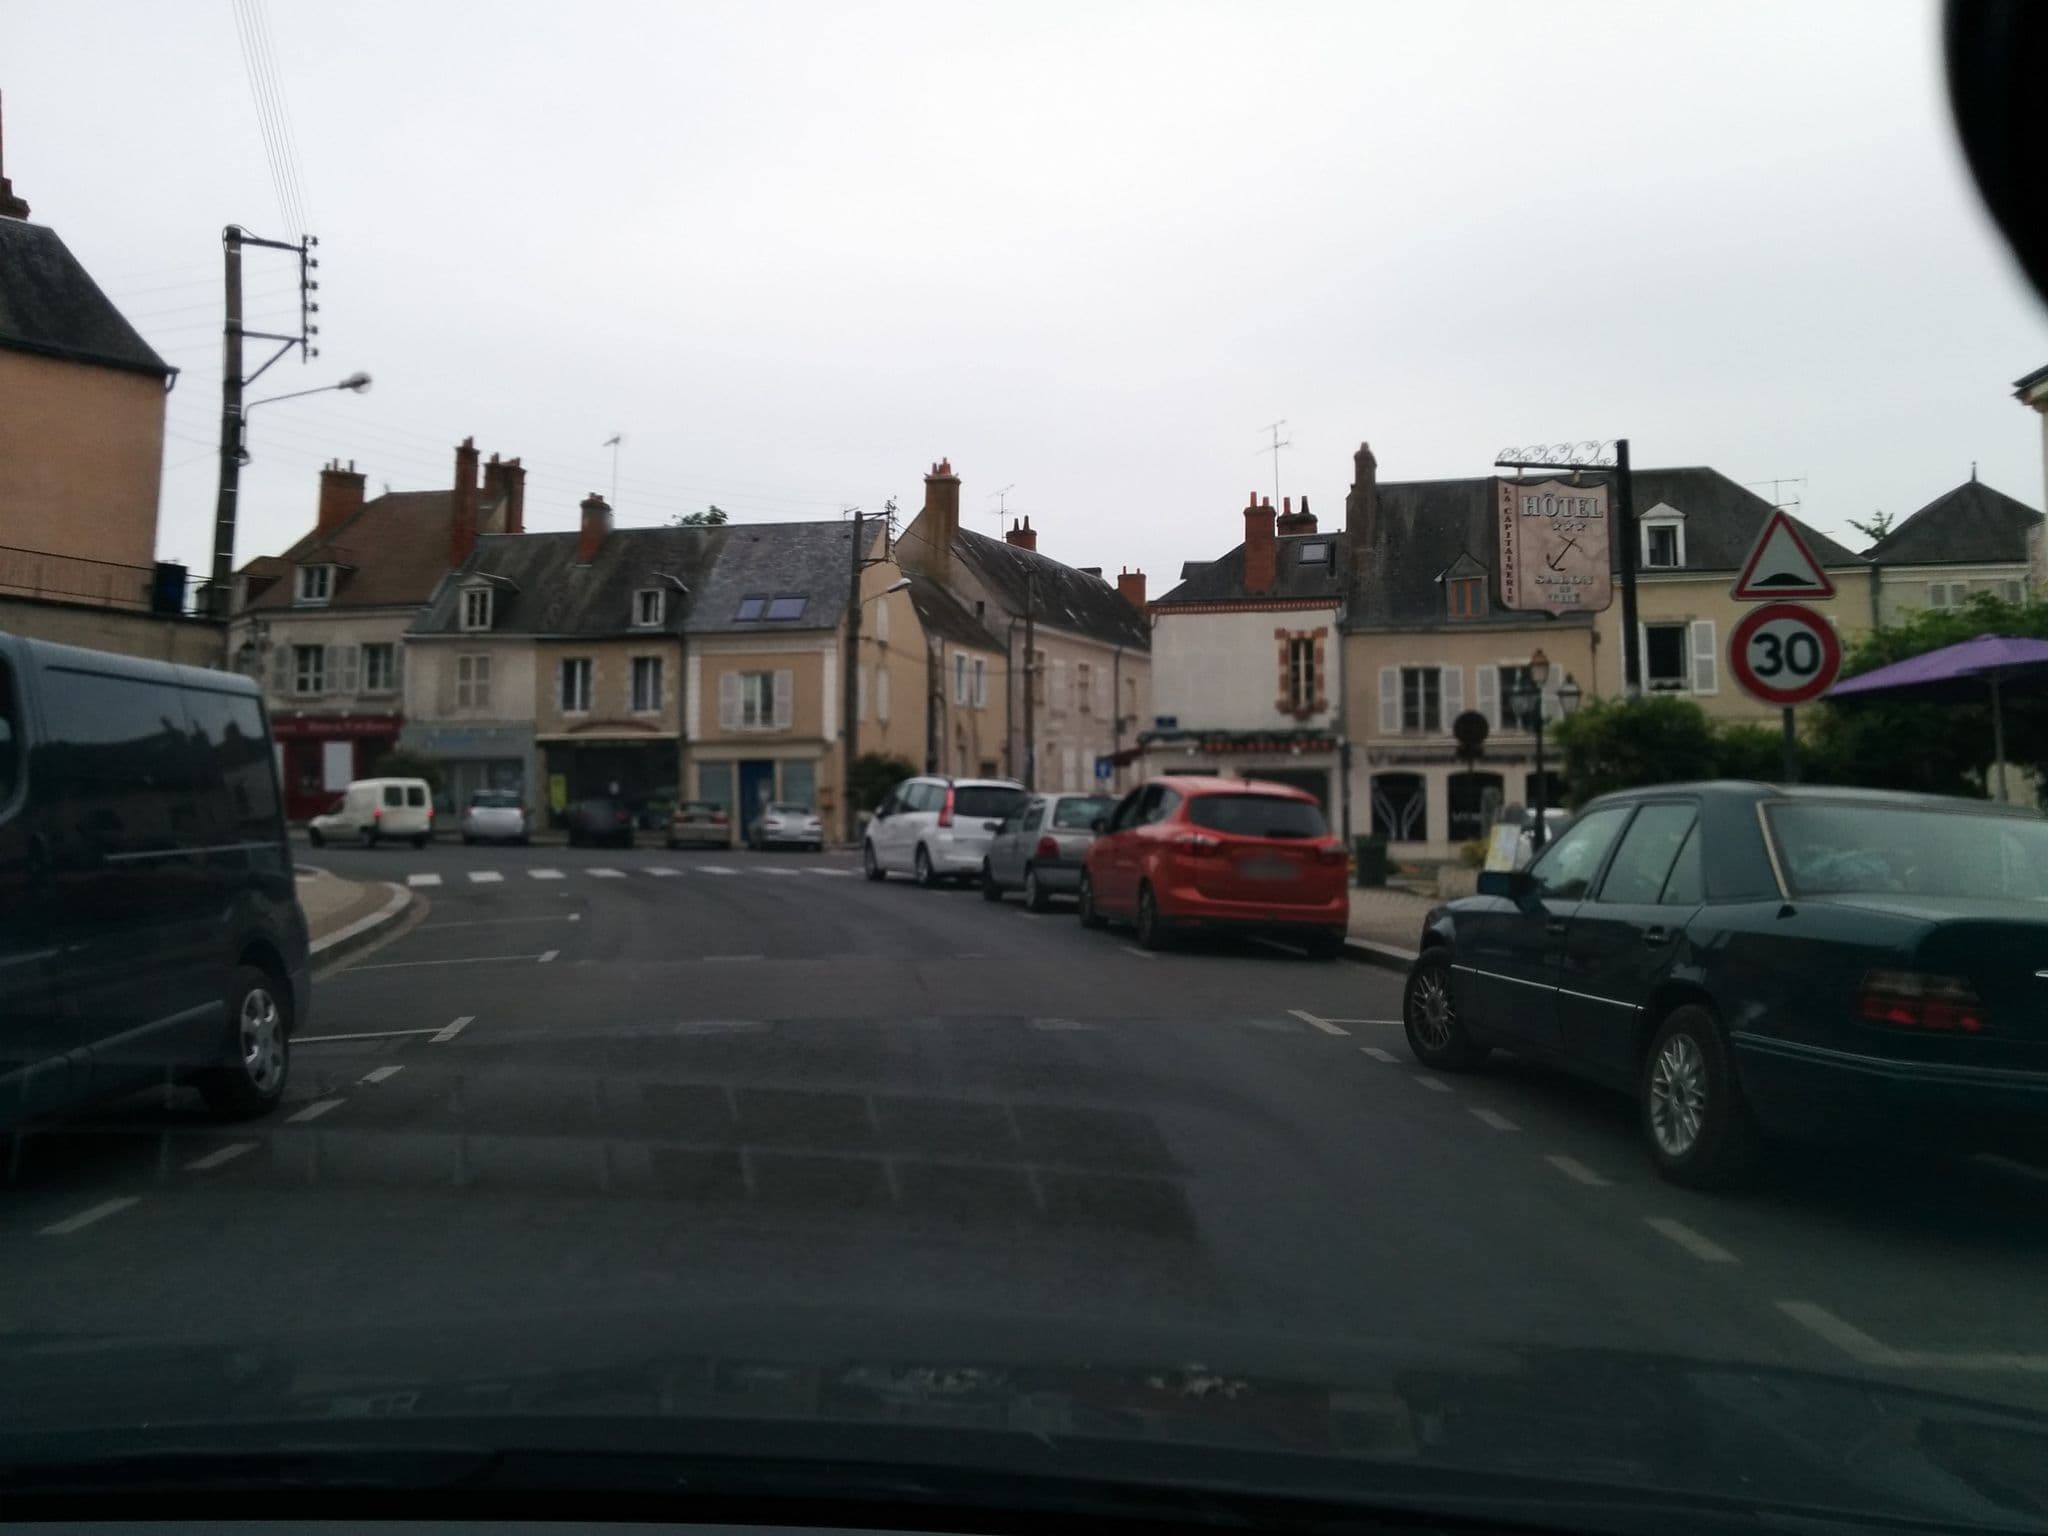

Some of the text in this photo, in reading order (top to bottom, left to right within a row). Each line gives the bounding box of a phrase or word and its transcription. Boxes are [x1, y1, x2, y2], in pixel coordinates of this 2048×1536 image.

[1503, 487, 1512, 502] LA
[1520, 492, 1603, 518] HÔTEL
[1752, 631, 1820, 677] 30
